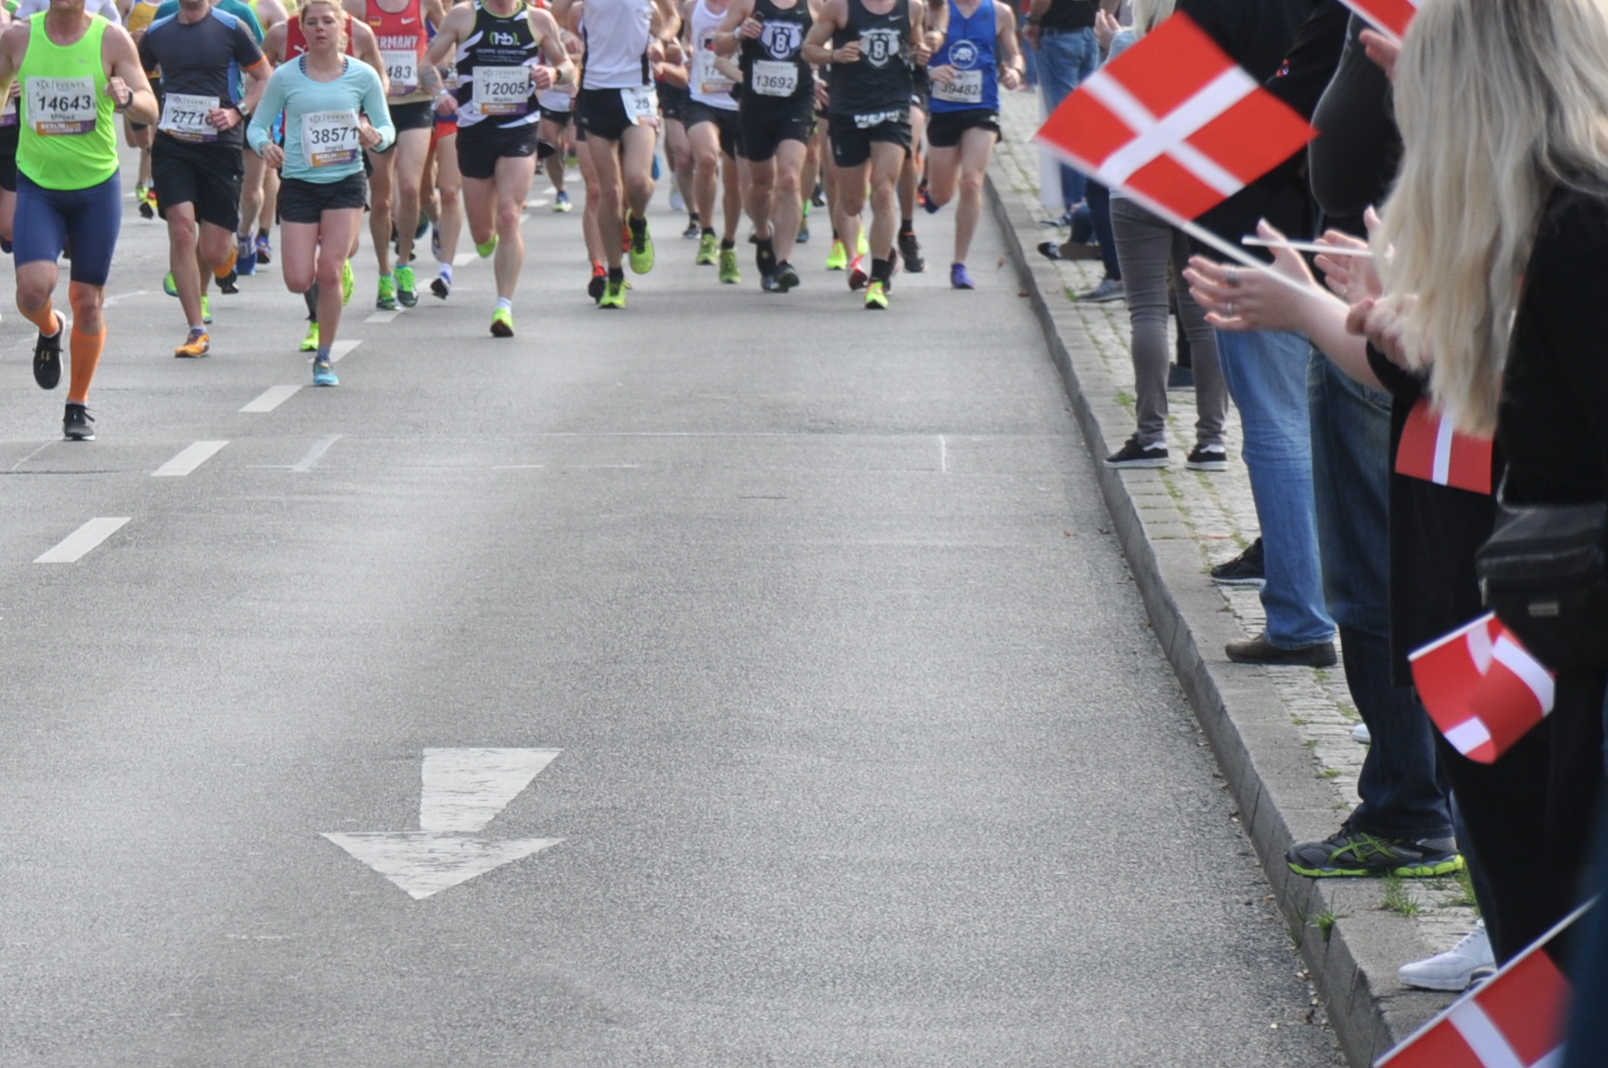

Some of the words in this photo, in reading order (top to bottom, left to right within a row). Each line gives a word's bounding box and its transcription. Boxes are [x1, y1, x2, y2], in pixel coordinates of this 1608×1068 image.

[376, 36, 418, 49] ERMANY
[484, 81, 526, 96] 12005
[755, 75, 794, 89] 13692
[38, 94, 92, 112] 14643
[311, 126, 358, 145] 38571
